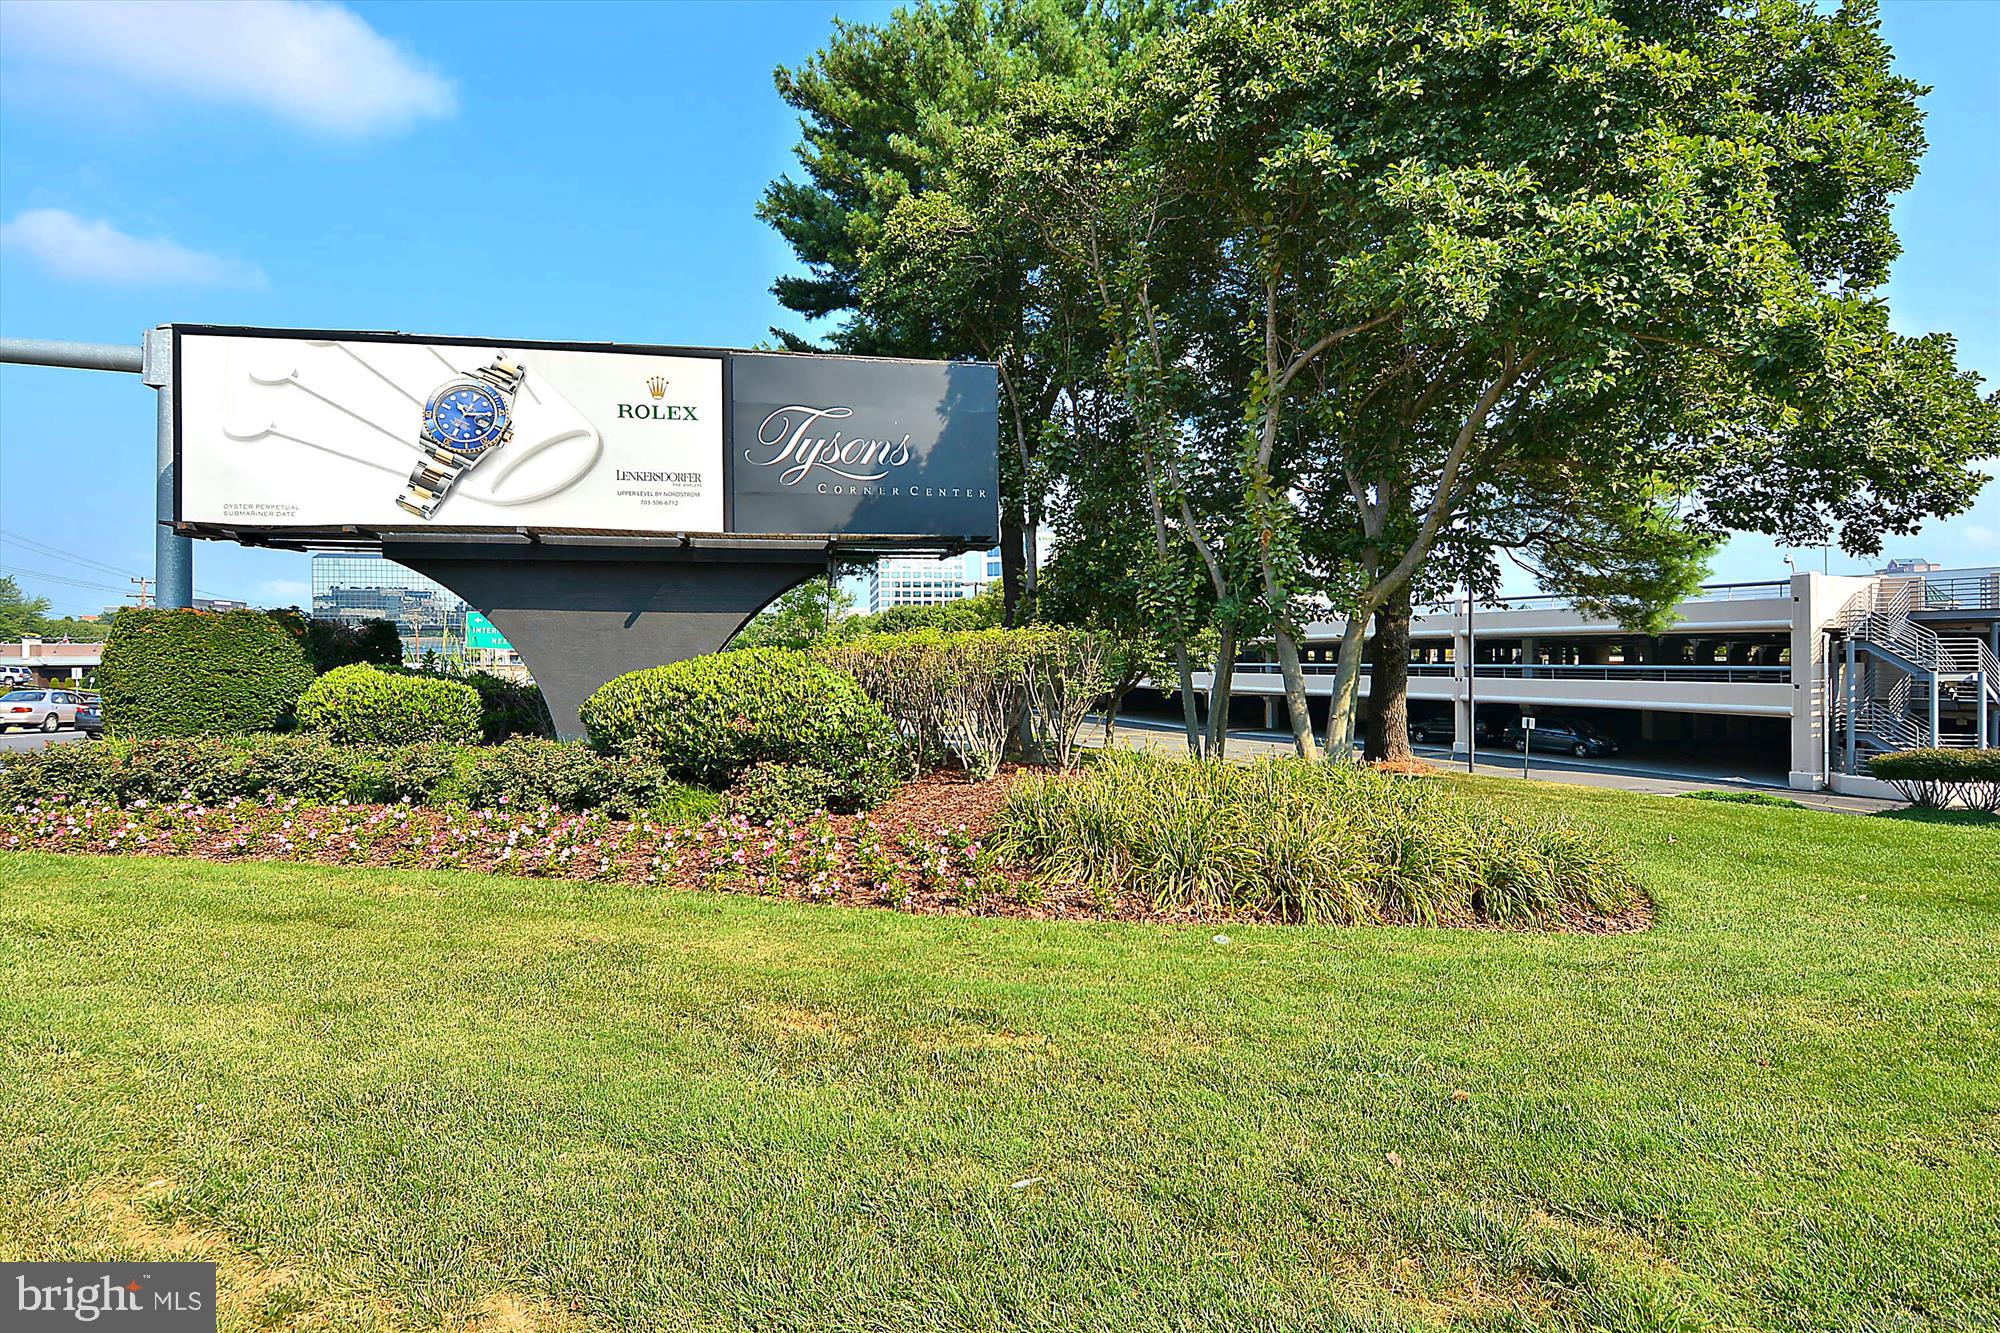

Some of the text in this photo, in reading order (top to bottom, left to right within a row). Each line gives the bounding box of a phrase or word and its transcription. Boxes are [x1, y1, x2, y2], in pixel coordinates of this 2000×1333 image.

[616, 403, 700, 421] ROLEX
[744, 405, 911, 486] Tysons
[616, 469, 702, 483] LENKERSDORFER
[817, 483, 987, 499] CORNER CENTER
[255, 503, 301, 511] PERPETUAL
